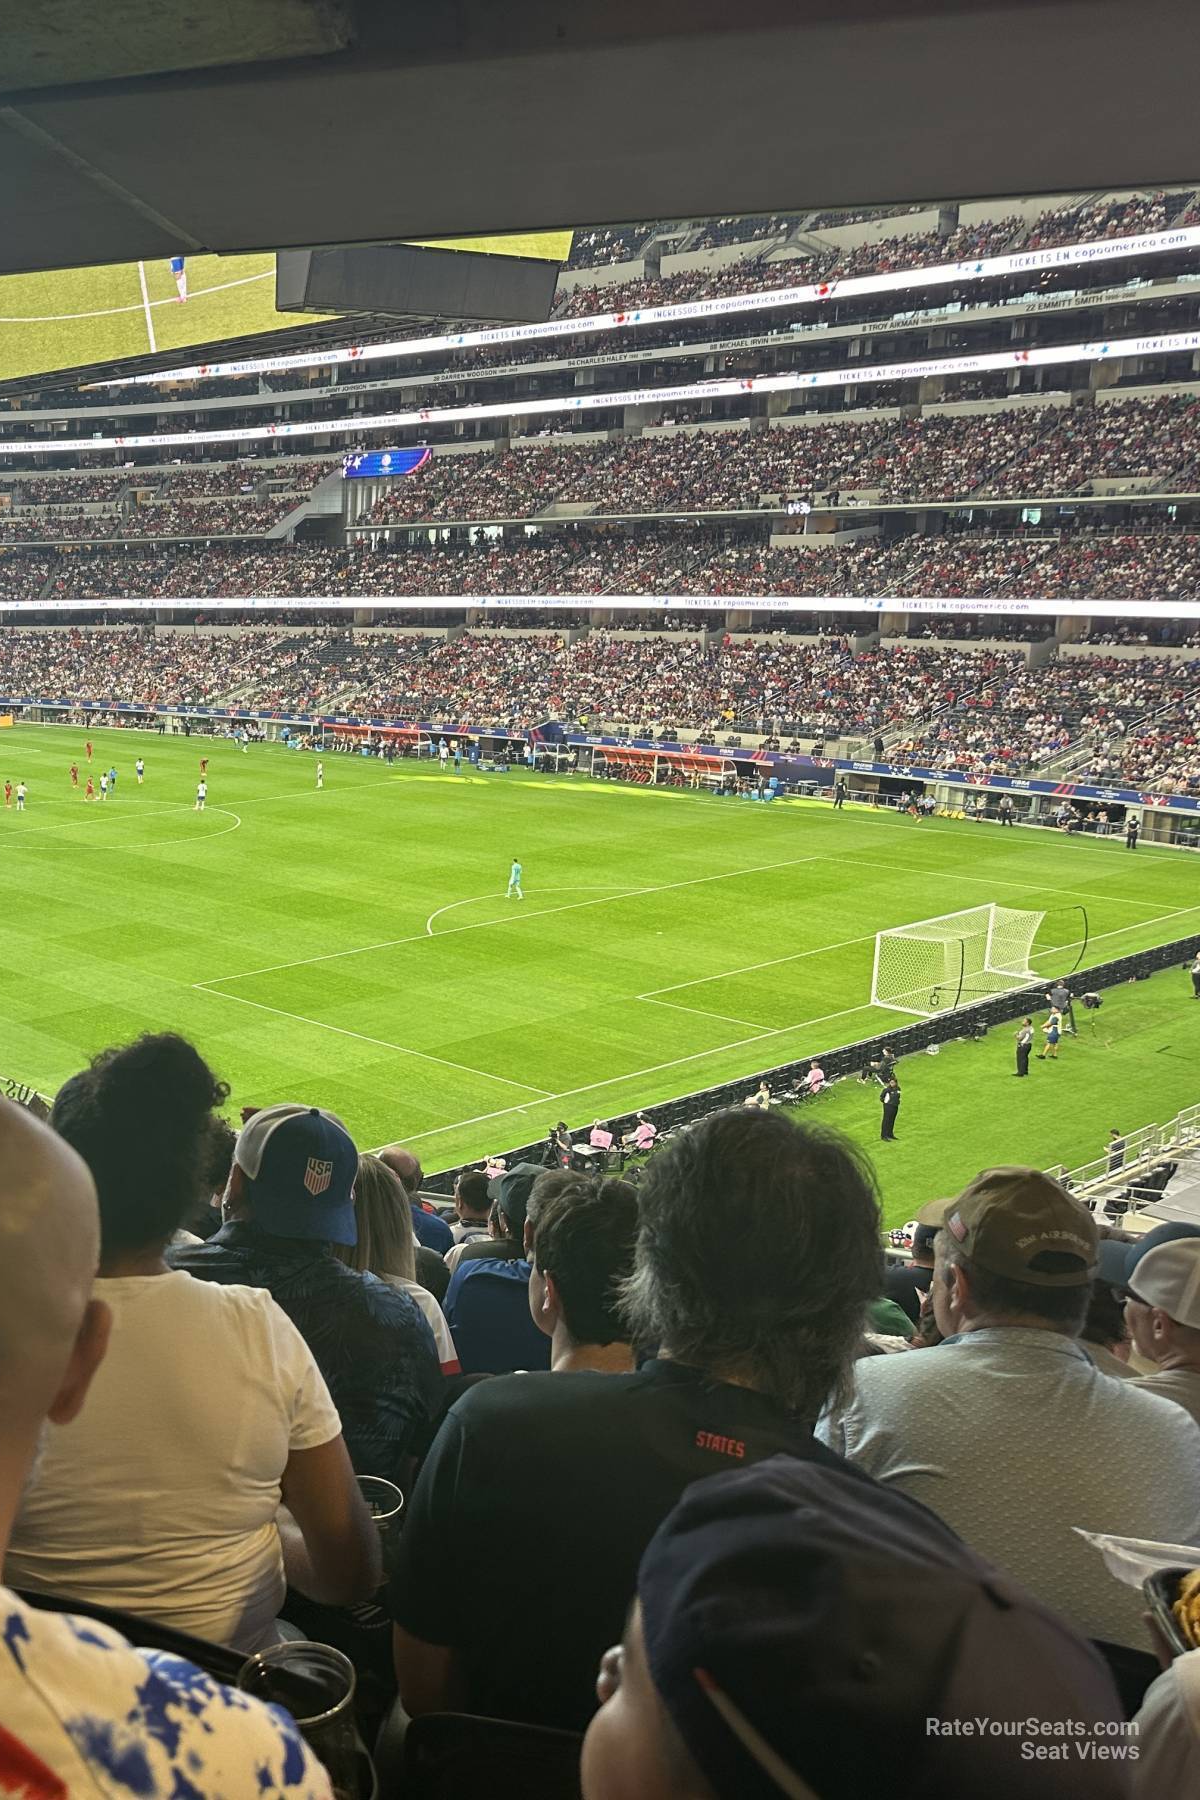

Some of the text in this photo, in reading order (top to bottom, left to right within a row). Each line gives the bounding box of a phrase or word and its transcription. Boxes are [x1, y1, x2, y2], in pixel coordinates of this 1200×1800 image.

[1009, 254, 1051, 268] TICKETS
[1056, 252, 1070, 262] EN
[1025, 303, 1036, 312] 22
[1038, 299, 1072, 310] EMMITT
[1074, 295, 1104, 306] SMITH
[868, 323, 888, 332] TROY
[889, 319, 919, 329] AIKMAN
[719, 340, 749, 350] MICHAEL
[750, 337, 769, 346] IRVIN
[1136, 339, 1180, 351] TICKETS
[576, 356, 606, 366] CHARLES
[606, 354, 628, 362] HALEY
[441, 373, 465, 381] DARREN
[467, 370, 497, 378] WOODSON
[341, 384, 367, 392] JOHNSON
[309, 1158, 332, 1176] USA
[695, 1430, 746, 1459] STATES
